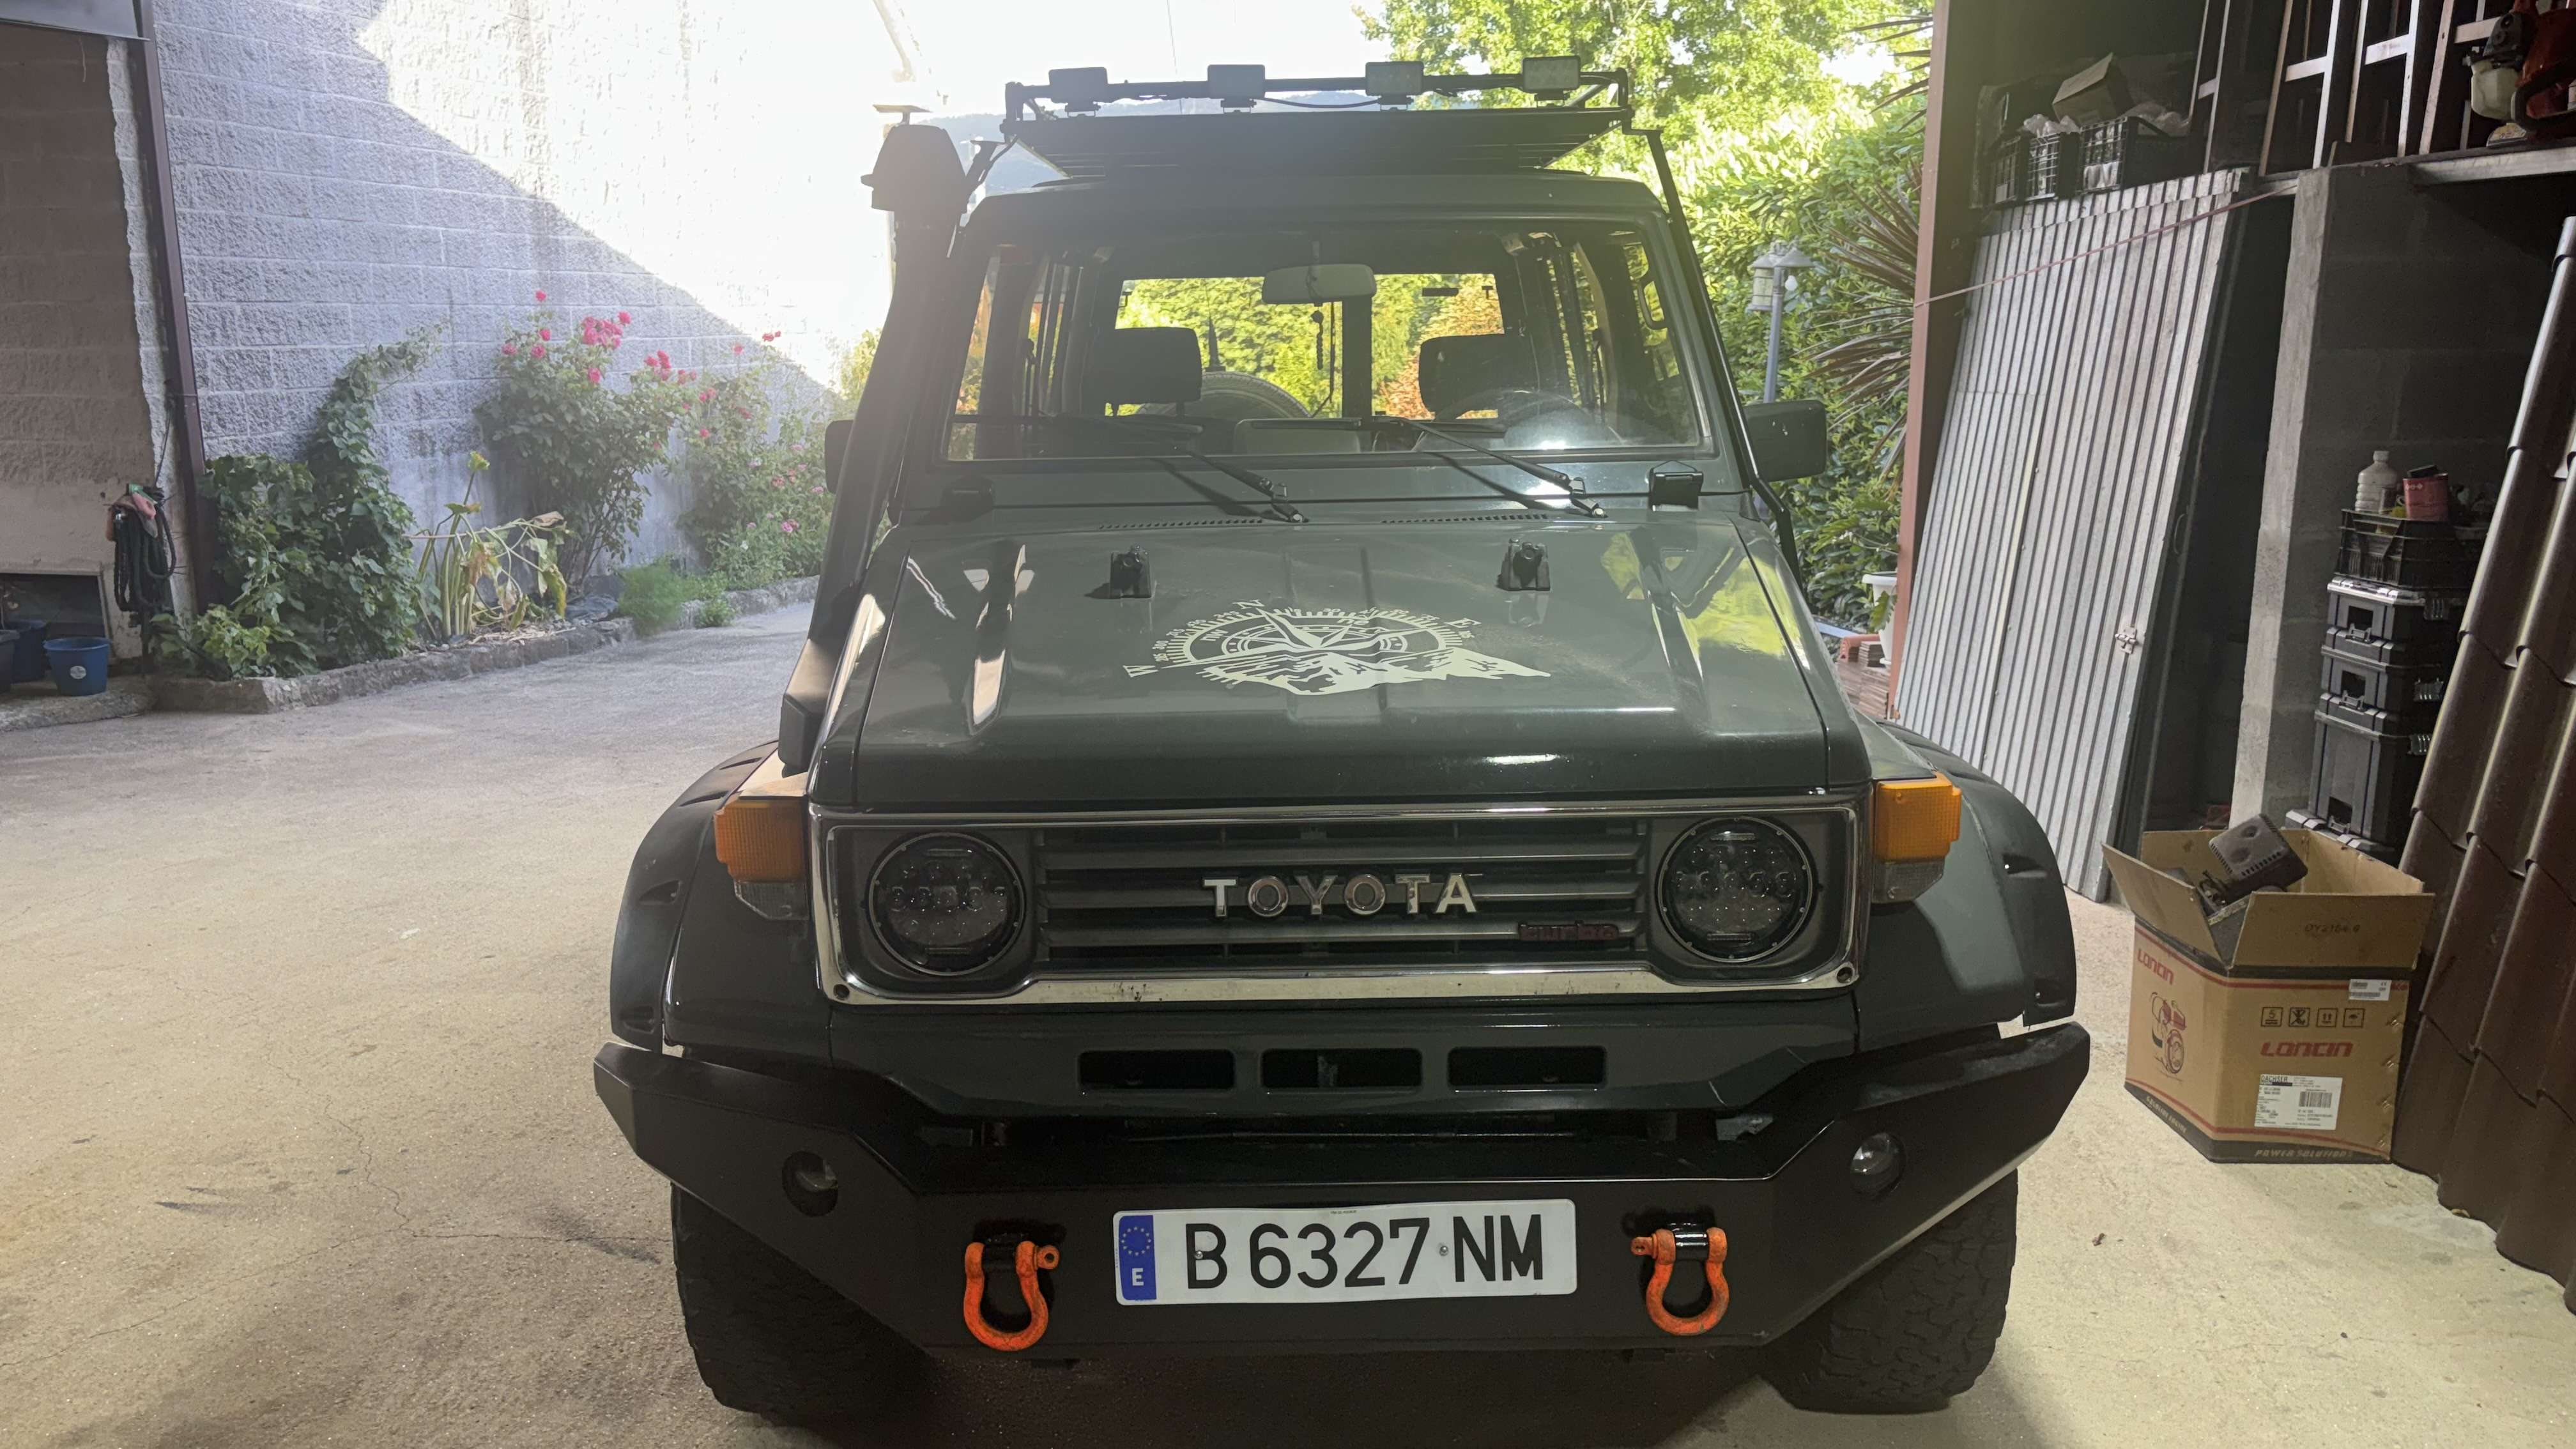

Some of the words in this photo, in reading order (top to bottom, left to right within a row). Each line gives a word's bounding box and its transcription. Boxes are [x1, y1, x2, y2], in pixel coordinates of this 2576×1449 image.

[1202, 872, 1478, 918] TOYOTA
[1185, 1222, 1227, 1289] B
[1250, 1216, 1430, 1289] 6327
[1453, 1214, 1544, 1283] NM
[1131, 1267, 1144, 1287] E
